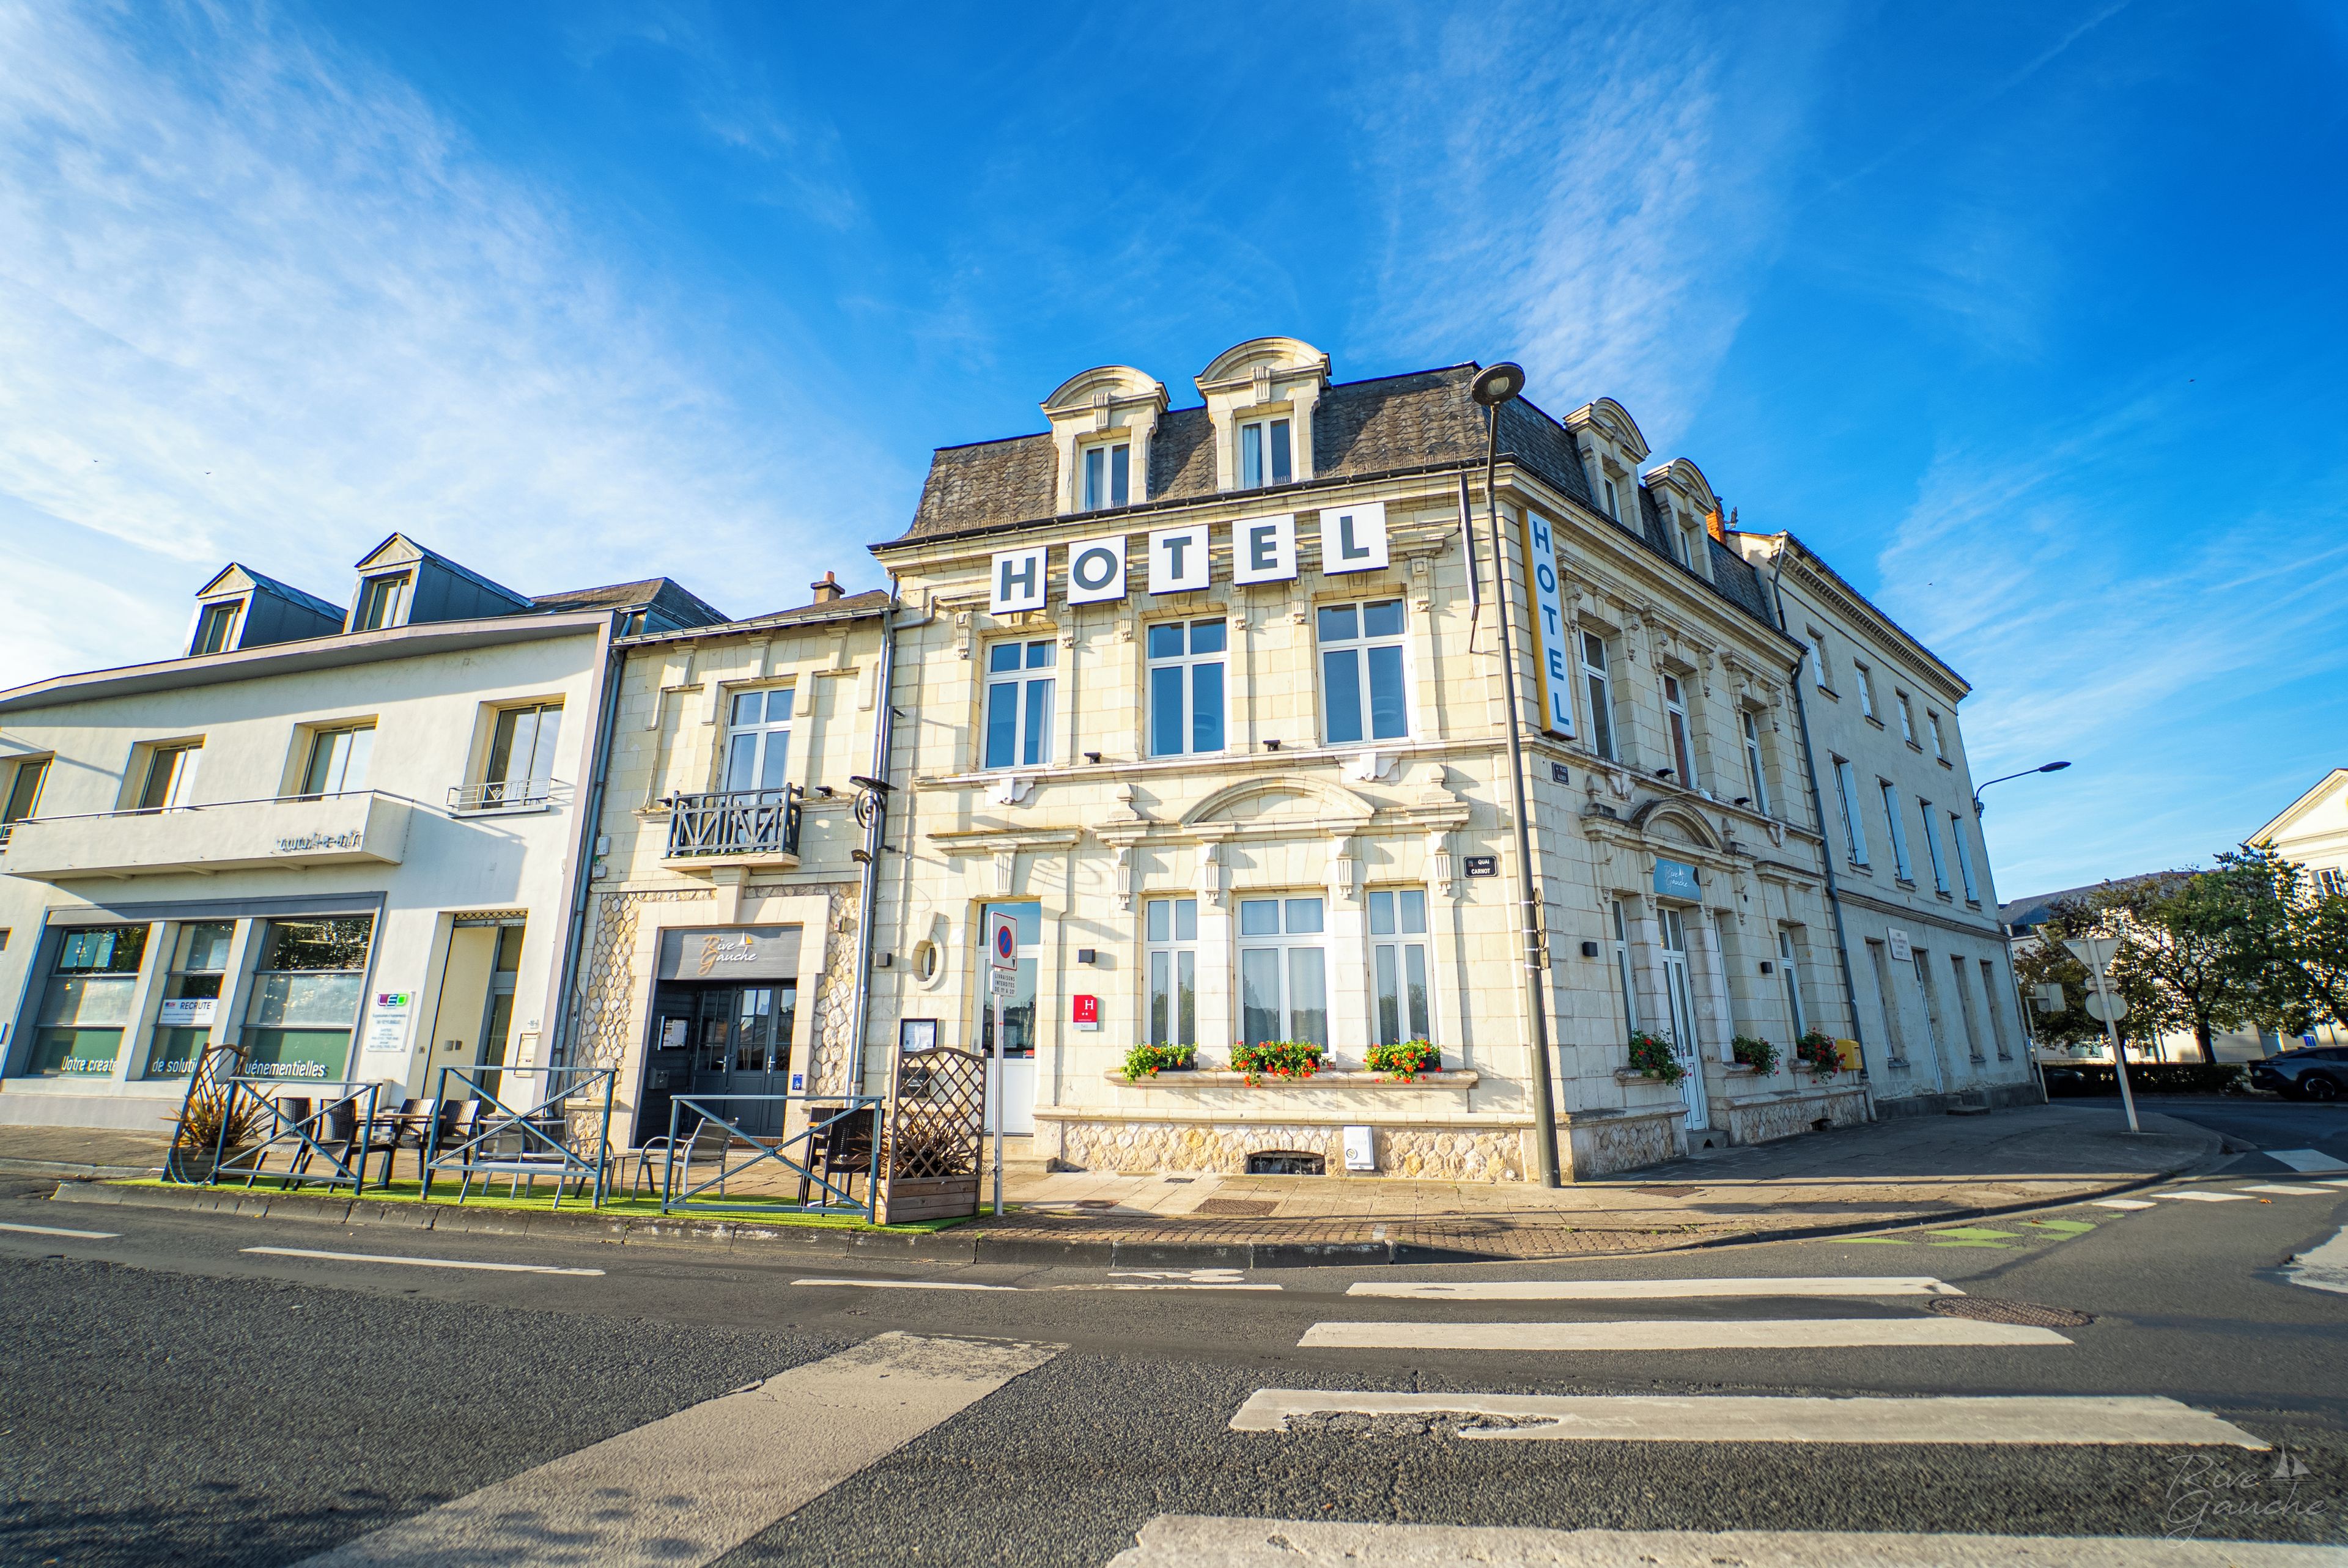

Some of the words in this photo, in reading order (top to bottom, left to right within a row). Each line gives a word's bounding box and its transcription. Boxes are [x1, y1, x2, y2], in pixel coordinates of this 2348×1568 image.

[1001, 515, 1370, 602] HOTEL
[1533, 521, 1570, 726] HOTEL
[1664, 865, 1678, 878] Rive
[1666, 875, 1688, 893] Gauche
[701, 935, 736, 955] Rive
[698, 947, 758, 975] Gauche
[994, 973, 1015, 982] LIVRAISONS
[994, 980, 1015, 988] INTERDITES
[180, 1001, 212, 1010] RECRUTE
[1084, 999, 1094, 1010] H
[151, 1058, 164, 1072] de
